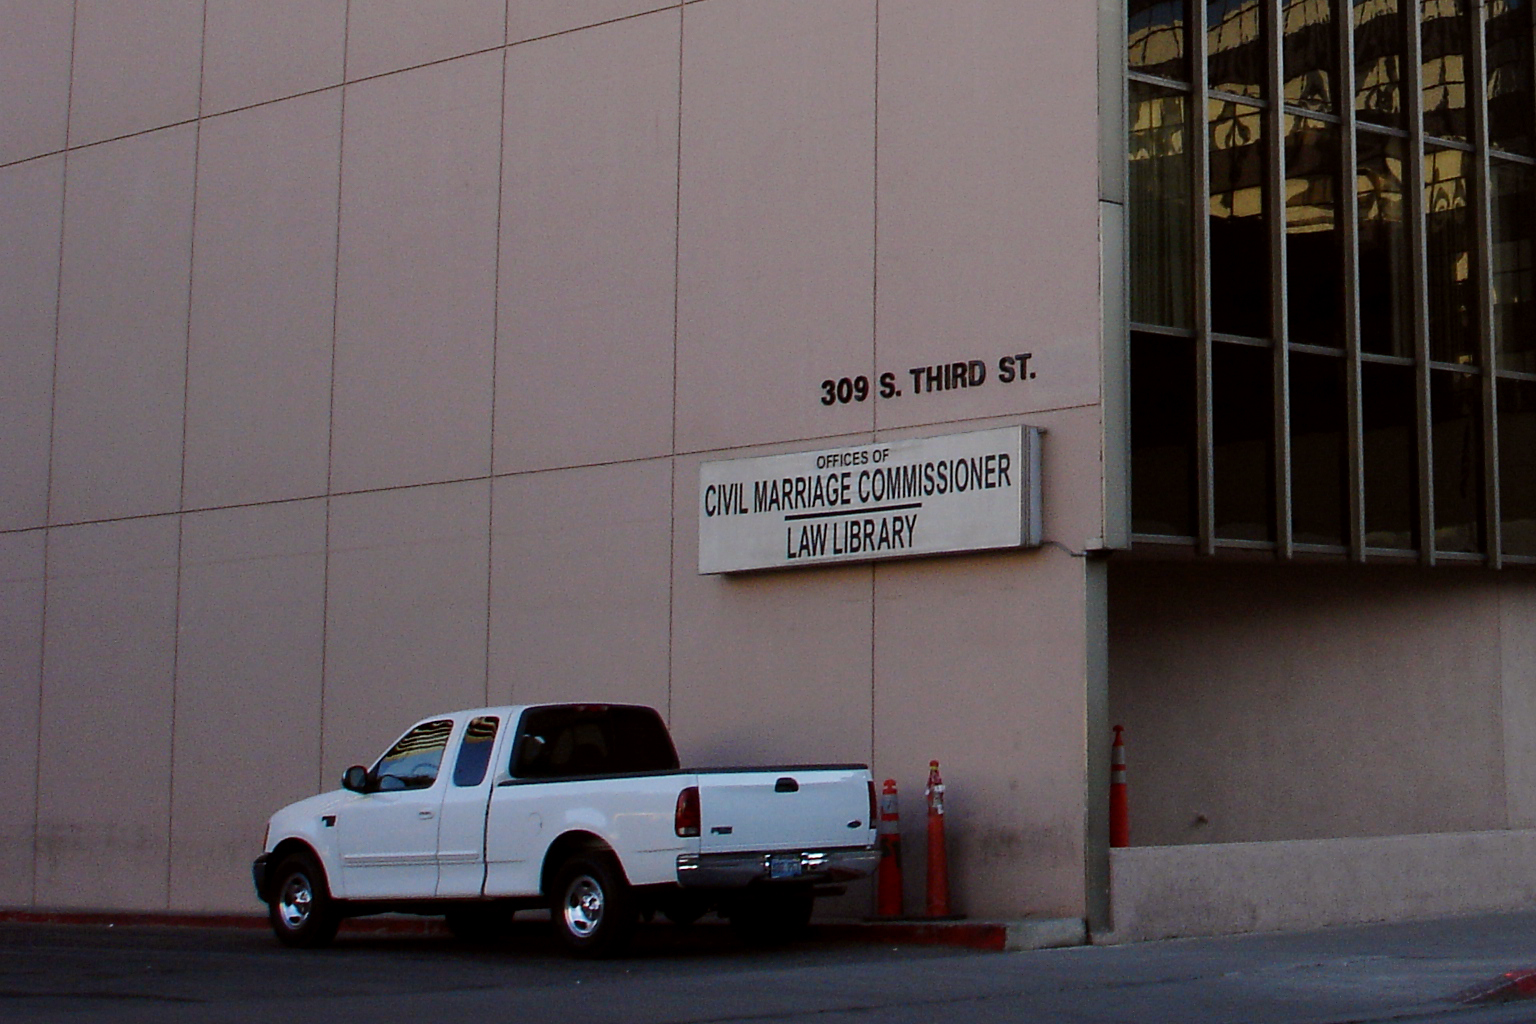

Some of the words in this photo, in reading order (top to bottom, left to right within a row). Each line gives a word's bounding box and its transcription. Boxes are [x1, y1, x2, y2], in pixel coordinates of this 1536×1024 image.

[820, 375, 869, 406] 309
[879, 372, 902, 399] S.
[909, 360, 986, 394] THIRD
[998, 353, 1037, 383] ST.
[816, 450, 869, 469] OFFICES
[872, 448, 889, 465] OF
[704, 482, 748, 517] CIVIL
[753, 471, 851, 513] MARRIAGE
[858, 453, 1011, 504] COMMISSIONER
[786, 522, 828, 560] LAW
[832, 513, 918, 555] LIBRARY
